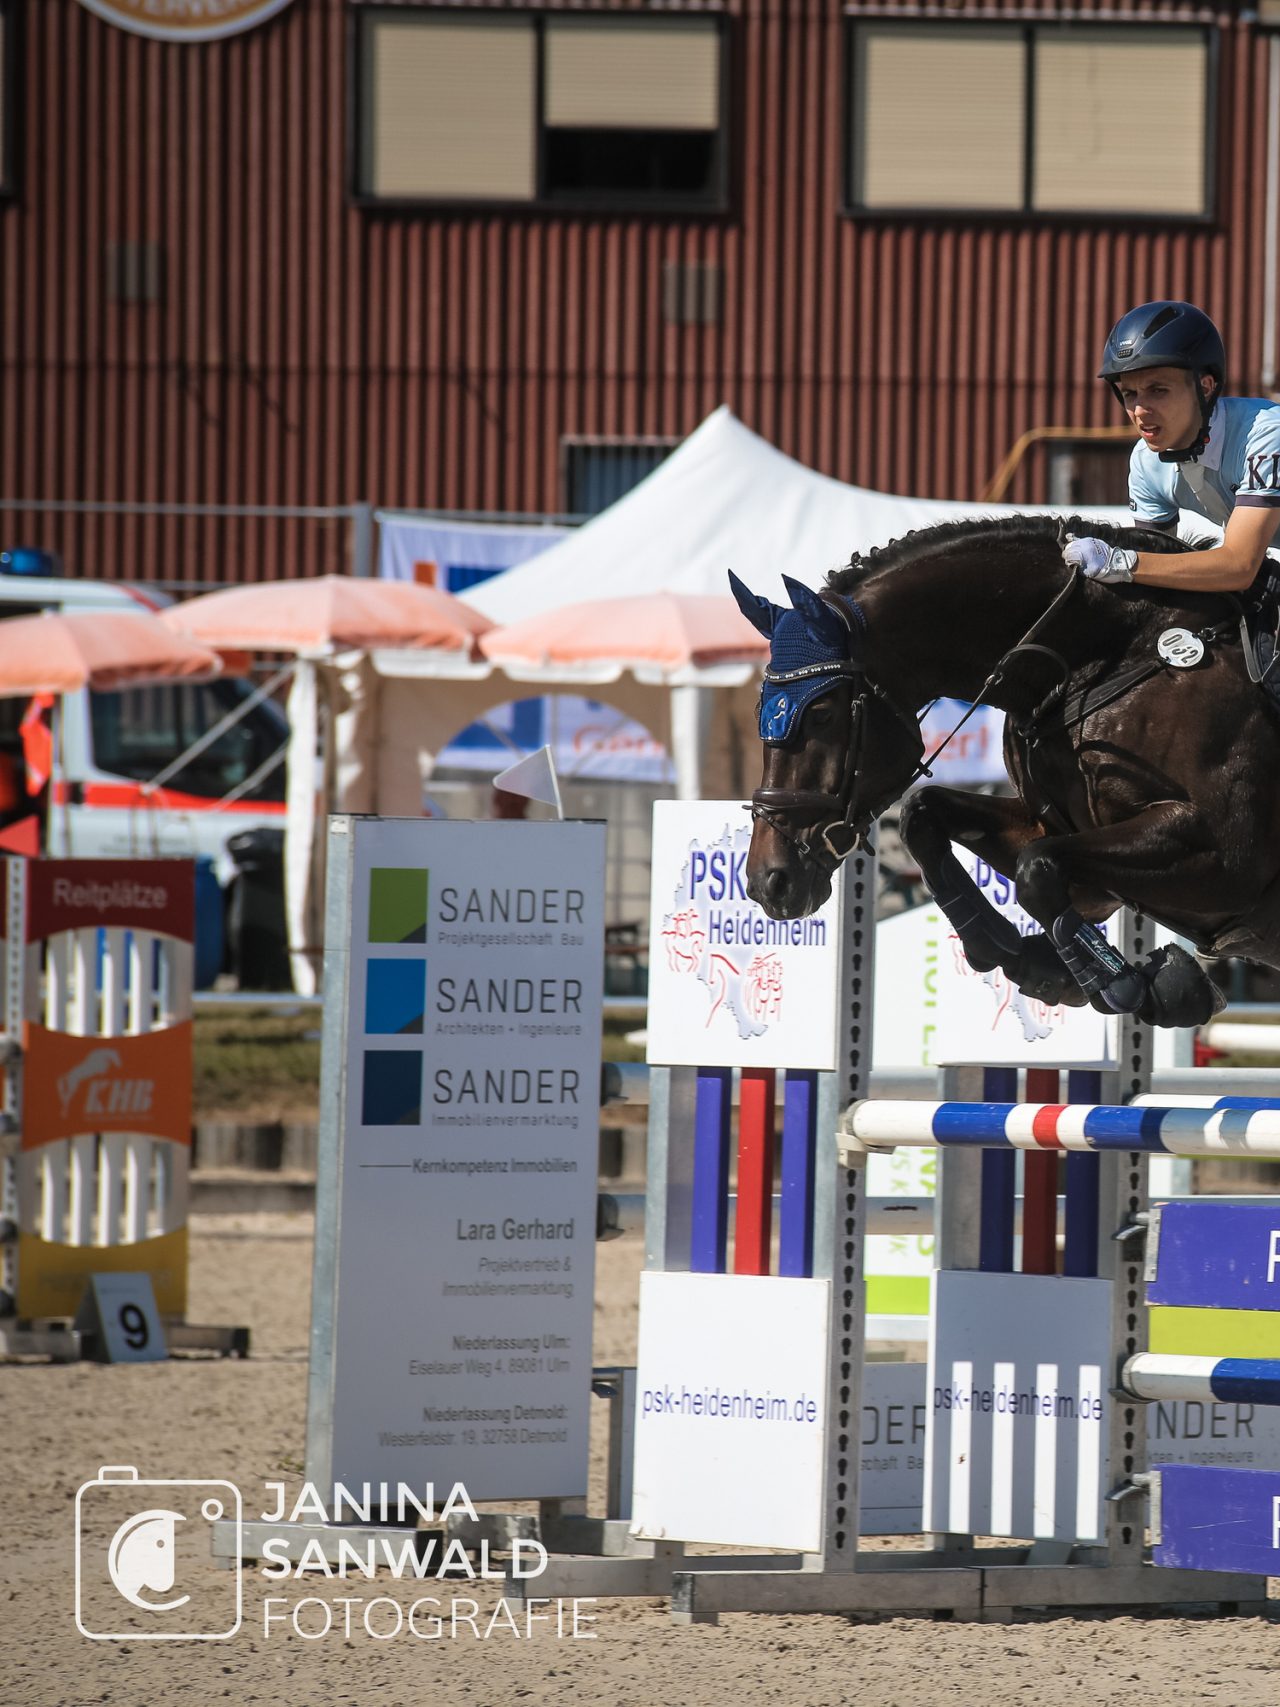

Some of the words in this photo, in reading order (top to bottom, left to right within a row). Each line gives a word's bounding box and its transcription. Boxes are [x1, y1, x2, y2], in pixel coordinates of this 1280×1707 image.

[690, 850, 746, 901] PSK
[976, 857, 1017, 906] PS
[53, 878, 168, 910] Reitplätze
[439, 888, 584, 923] SANDER
[561, 931, 584, 946] Bau
[436, 978, 582, 1013] SANDER
[435, 1021, 504, 1036] Architekten
[518, 1021, 582, 1038] Ingenieure
[433, 1069, 580, 1104] SANDER
[413, 1158, 508, 1176] Kernkompetenz
[511, 1158, 577, 1173] Immobilien
[457, 1219, 496, 1241] Lara
[502, 1217, 575, 1241] Gerhard
[119, 1303, 150, 1350] 9
[453, 1335, 540, 1353] Niederlassung
[465, 1359, 492, 1378] Weg
[423, 1406, 511, 1424] Niederlassung
[642, 1385, 817, 1423] psk-heidenheim.de
[933, 1383, 1104, 1421] psk-heidenheim.de
